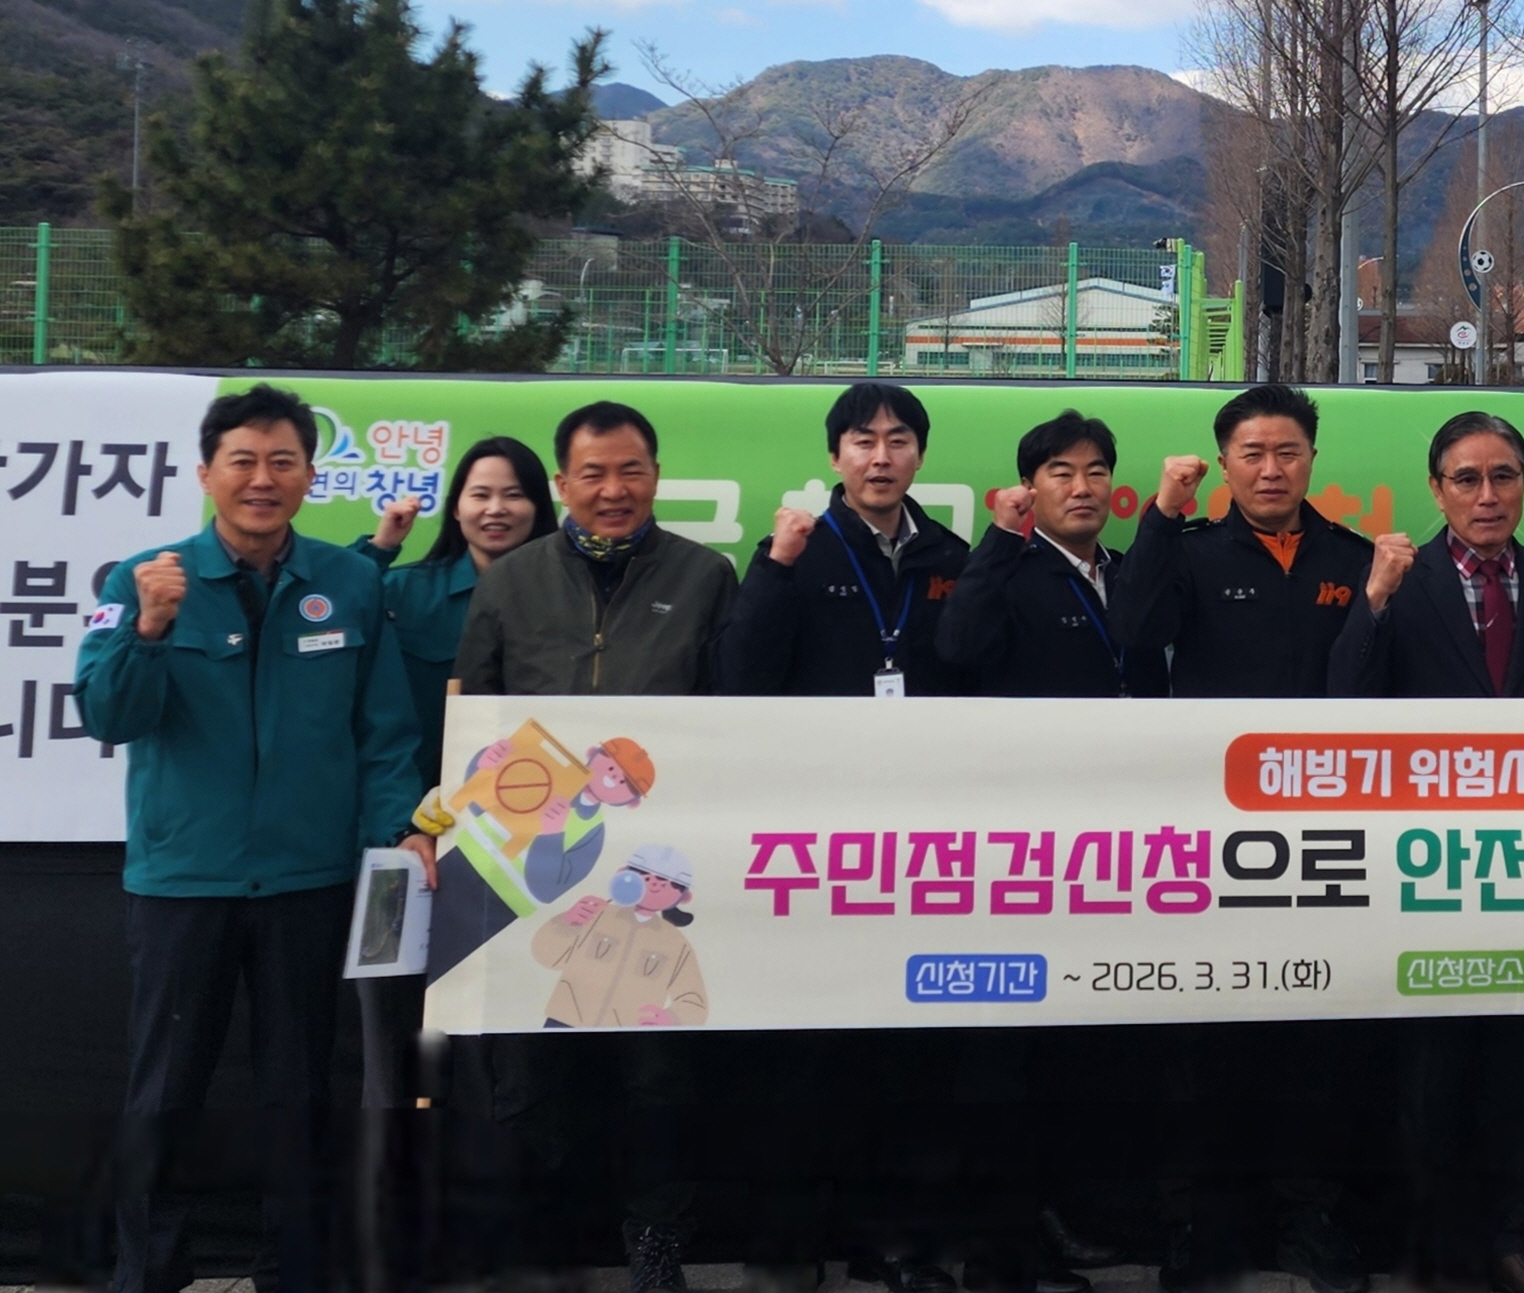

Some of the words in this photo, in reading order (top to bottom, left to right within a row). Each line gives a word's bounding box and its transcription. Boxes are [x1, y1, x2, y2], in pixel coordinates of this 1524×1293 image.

[372, 425, 444, 465] 안녕
[0, 440, 177, 517] 가자
[366, 469, 440, 513] 창녕
[1259, 746, 1391, 798] 해빙기
[744, 825, 1370, 917] 주민점검신청으로
[914, 960, 1039, 995] 신청기간
[1091, 961, 1185, 992] 2026.
[1194, 961, 1221, 992] 3.
